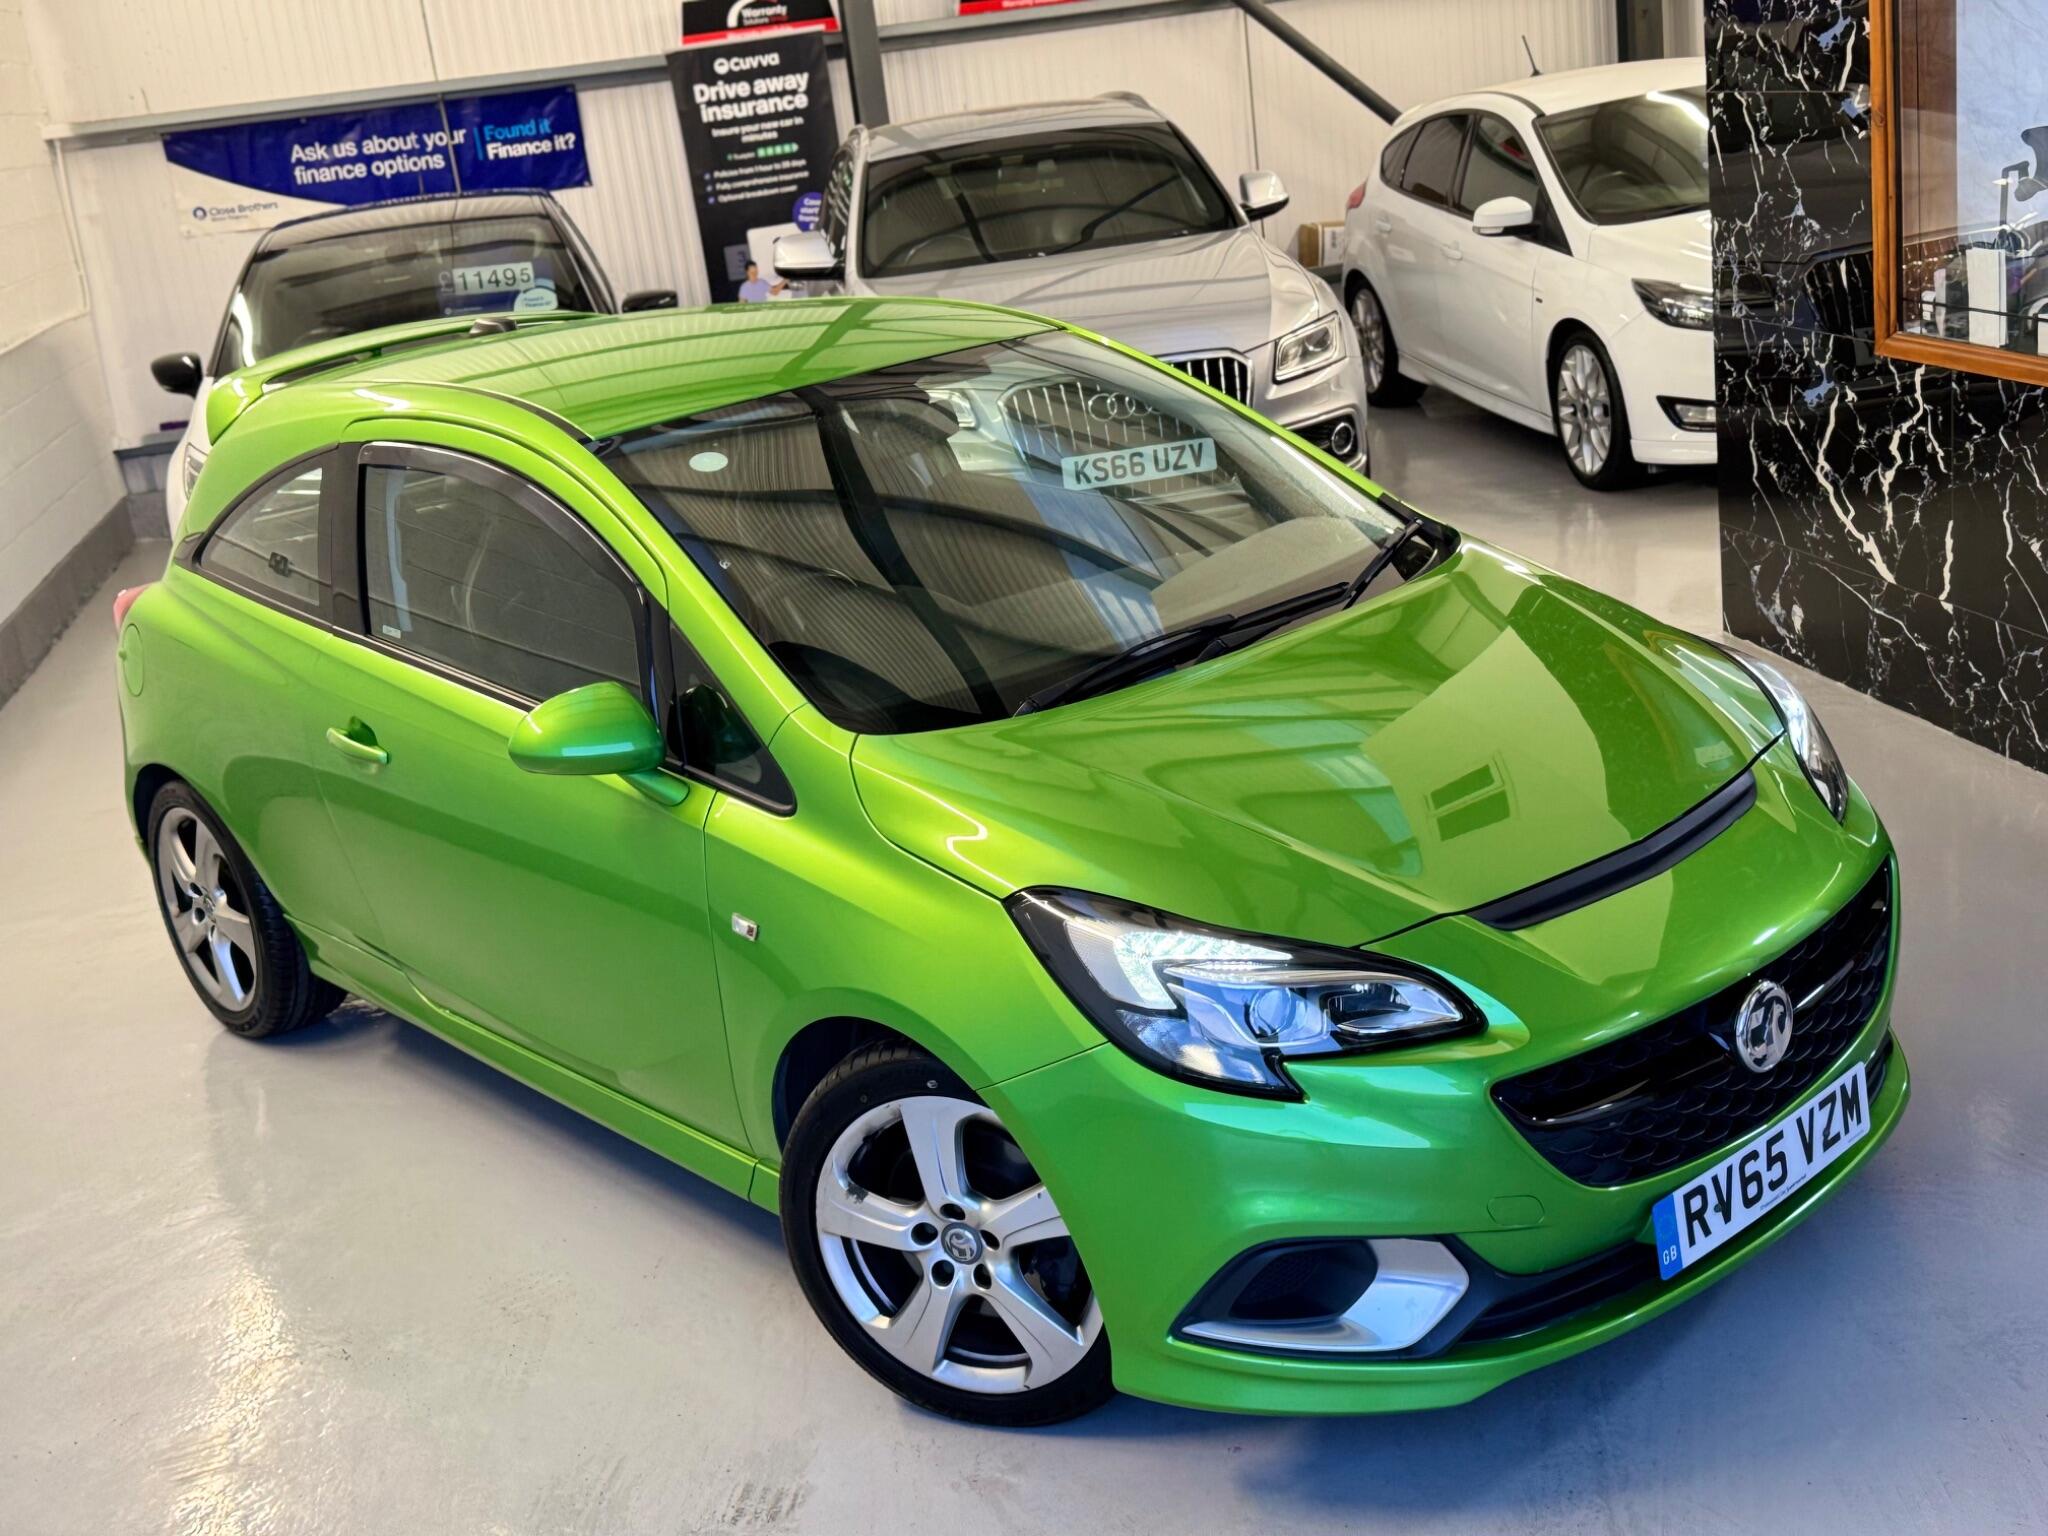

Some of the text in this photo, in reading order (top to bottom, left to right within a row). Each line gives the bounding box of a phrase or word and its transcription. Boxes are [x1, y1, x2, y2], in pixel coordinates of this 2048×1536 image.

[729, 52, 780, 72] cuvva
[693, 72, 809, 104] Drive away
[700, 93, 809, 123] insurance
[484, 118, 552, 141] Found it
[291, 129, 467, 164] Ask us about your
[486, 132, 576, 160] Finance it?
[293, 153, 446, 185] finance options
[1073, 442, 1203, 485] KS66 UZV
[1682, 1074, 1862, 1248] RV65 VZM
[1663, 1244, 1678, 1265] GB
